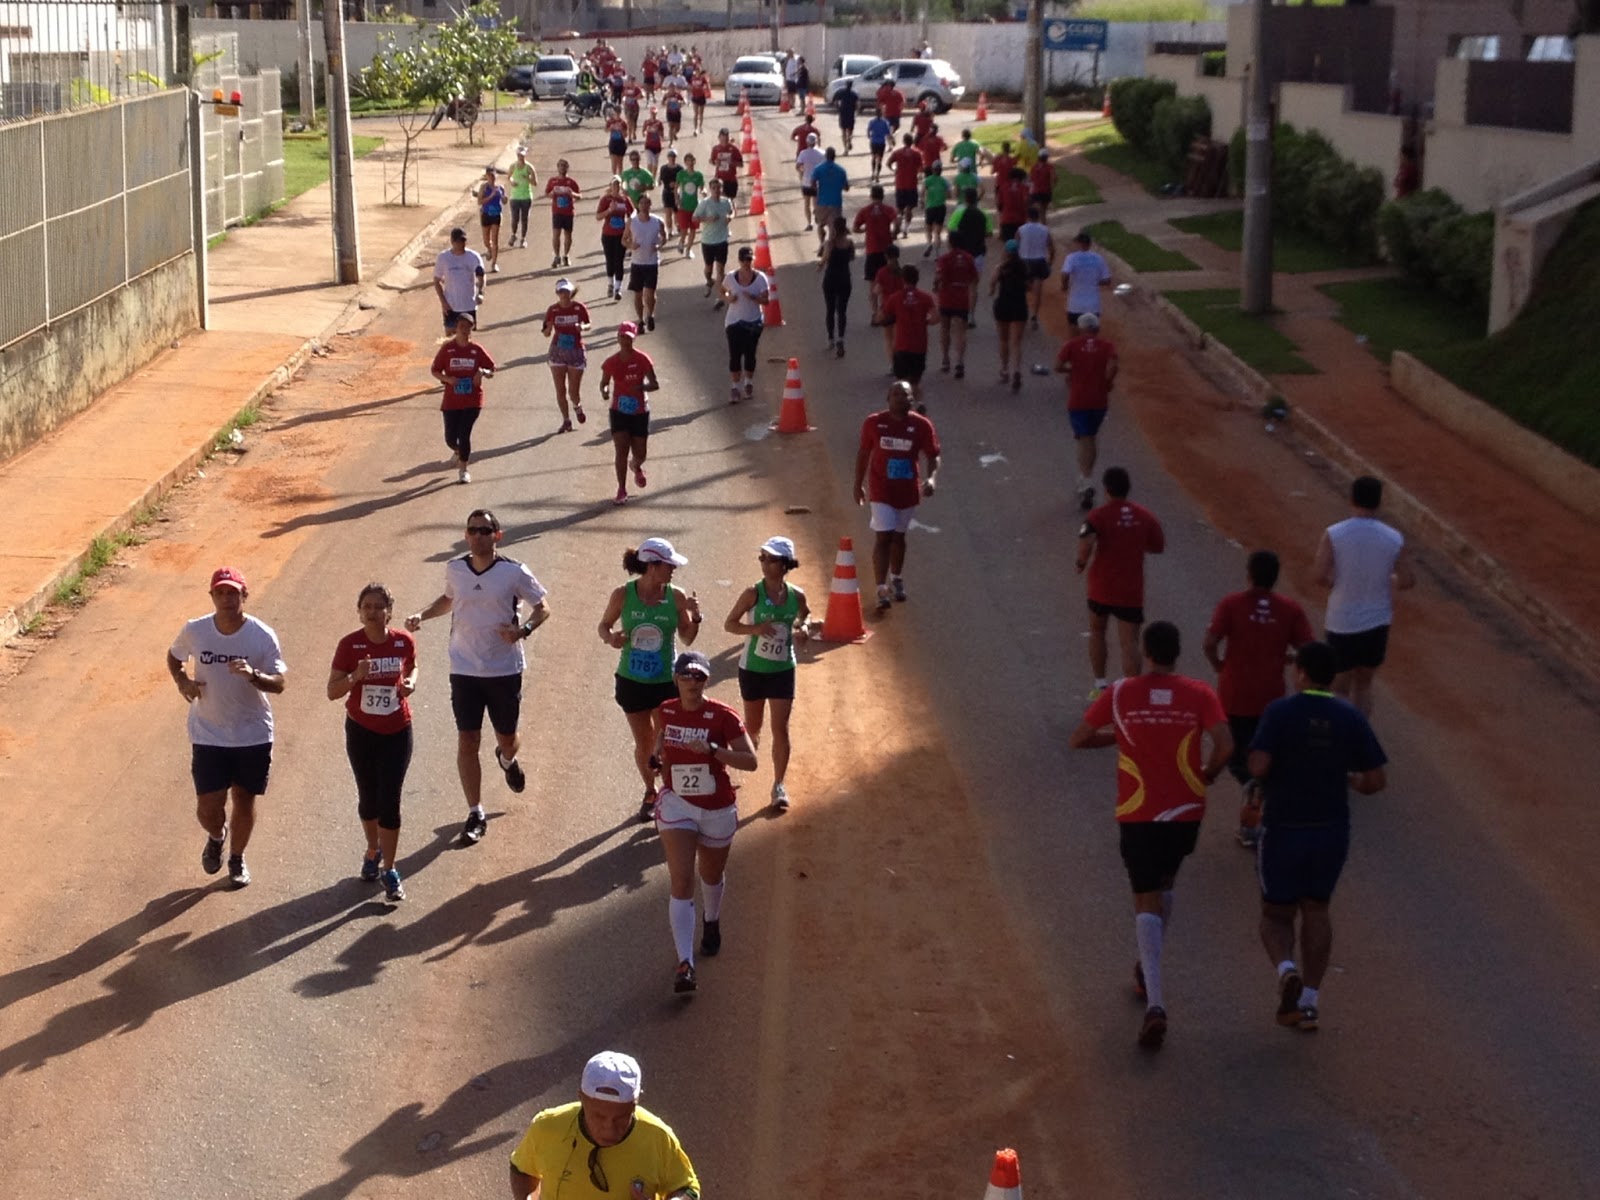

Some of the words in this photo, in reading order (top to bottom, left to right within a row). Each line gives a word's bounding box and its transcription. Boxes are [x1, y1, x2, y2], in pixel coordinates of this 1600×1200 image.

[761, 642, 783, 655] 510
[631, 658, 658, 672] 1787
[366, 695, 390, 708] 379
[685, 727, 709, 739] RUN
[682, 775, 700, 788] 22
